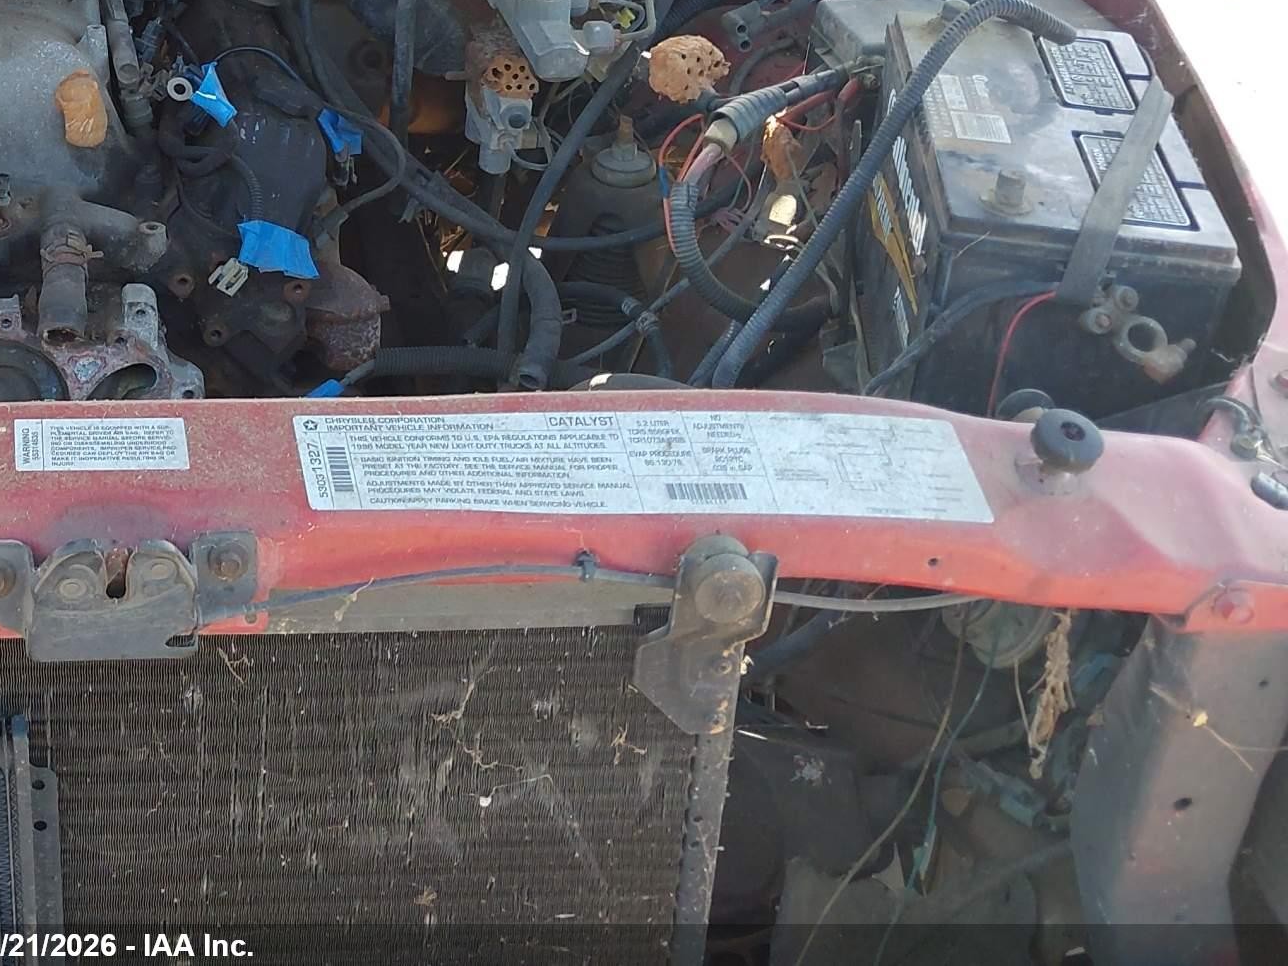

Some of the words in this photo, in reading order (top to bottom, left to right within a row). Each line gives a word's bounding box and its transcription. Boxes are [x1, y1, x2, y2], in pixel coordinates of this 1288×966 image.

[377, 416, 445, 424] CORPORATION
[548, 416, 614, 427] CATALYST
[22, 428, 30, 464] WARNING
[306, 442, 329, 498] 53031327
